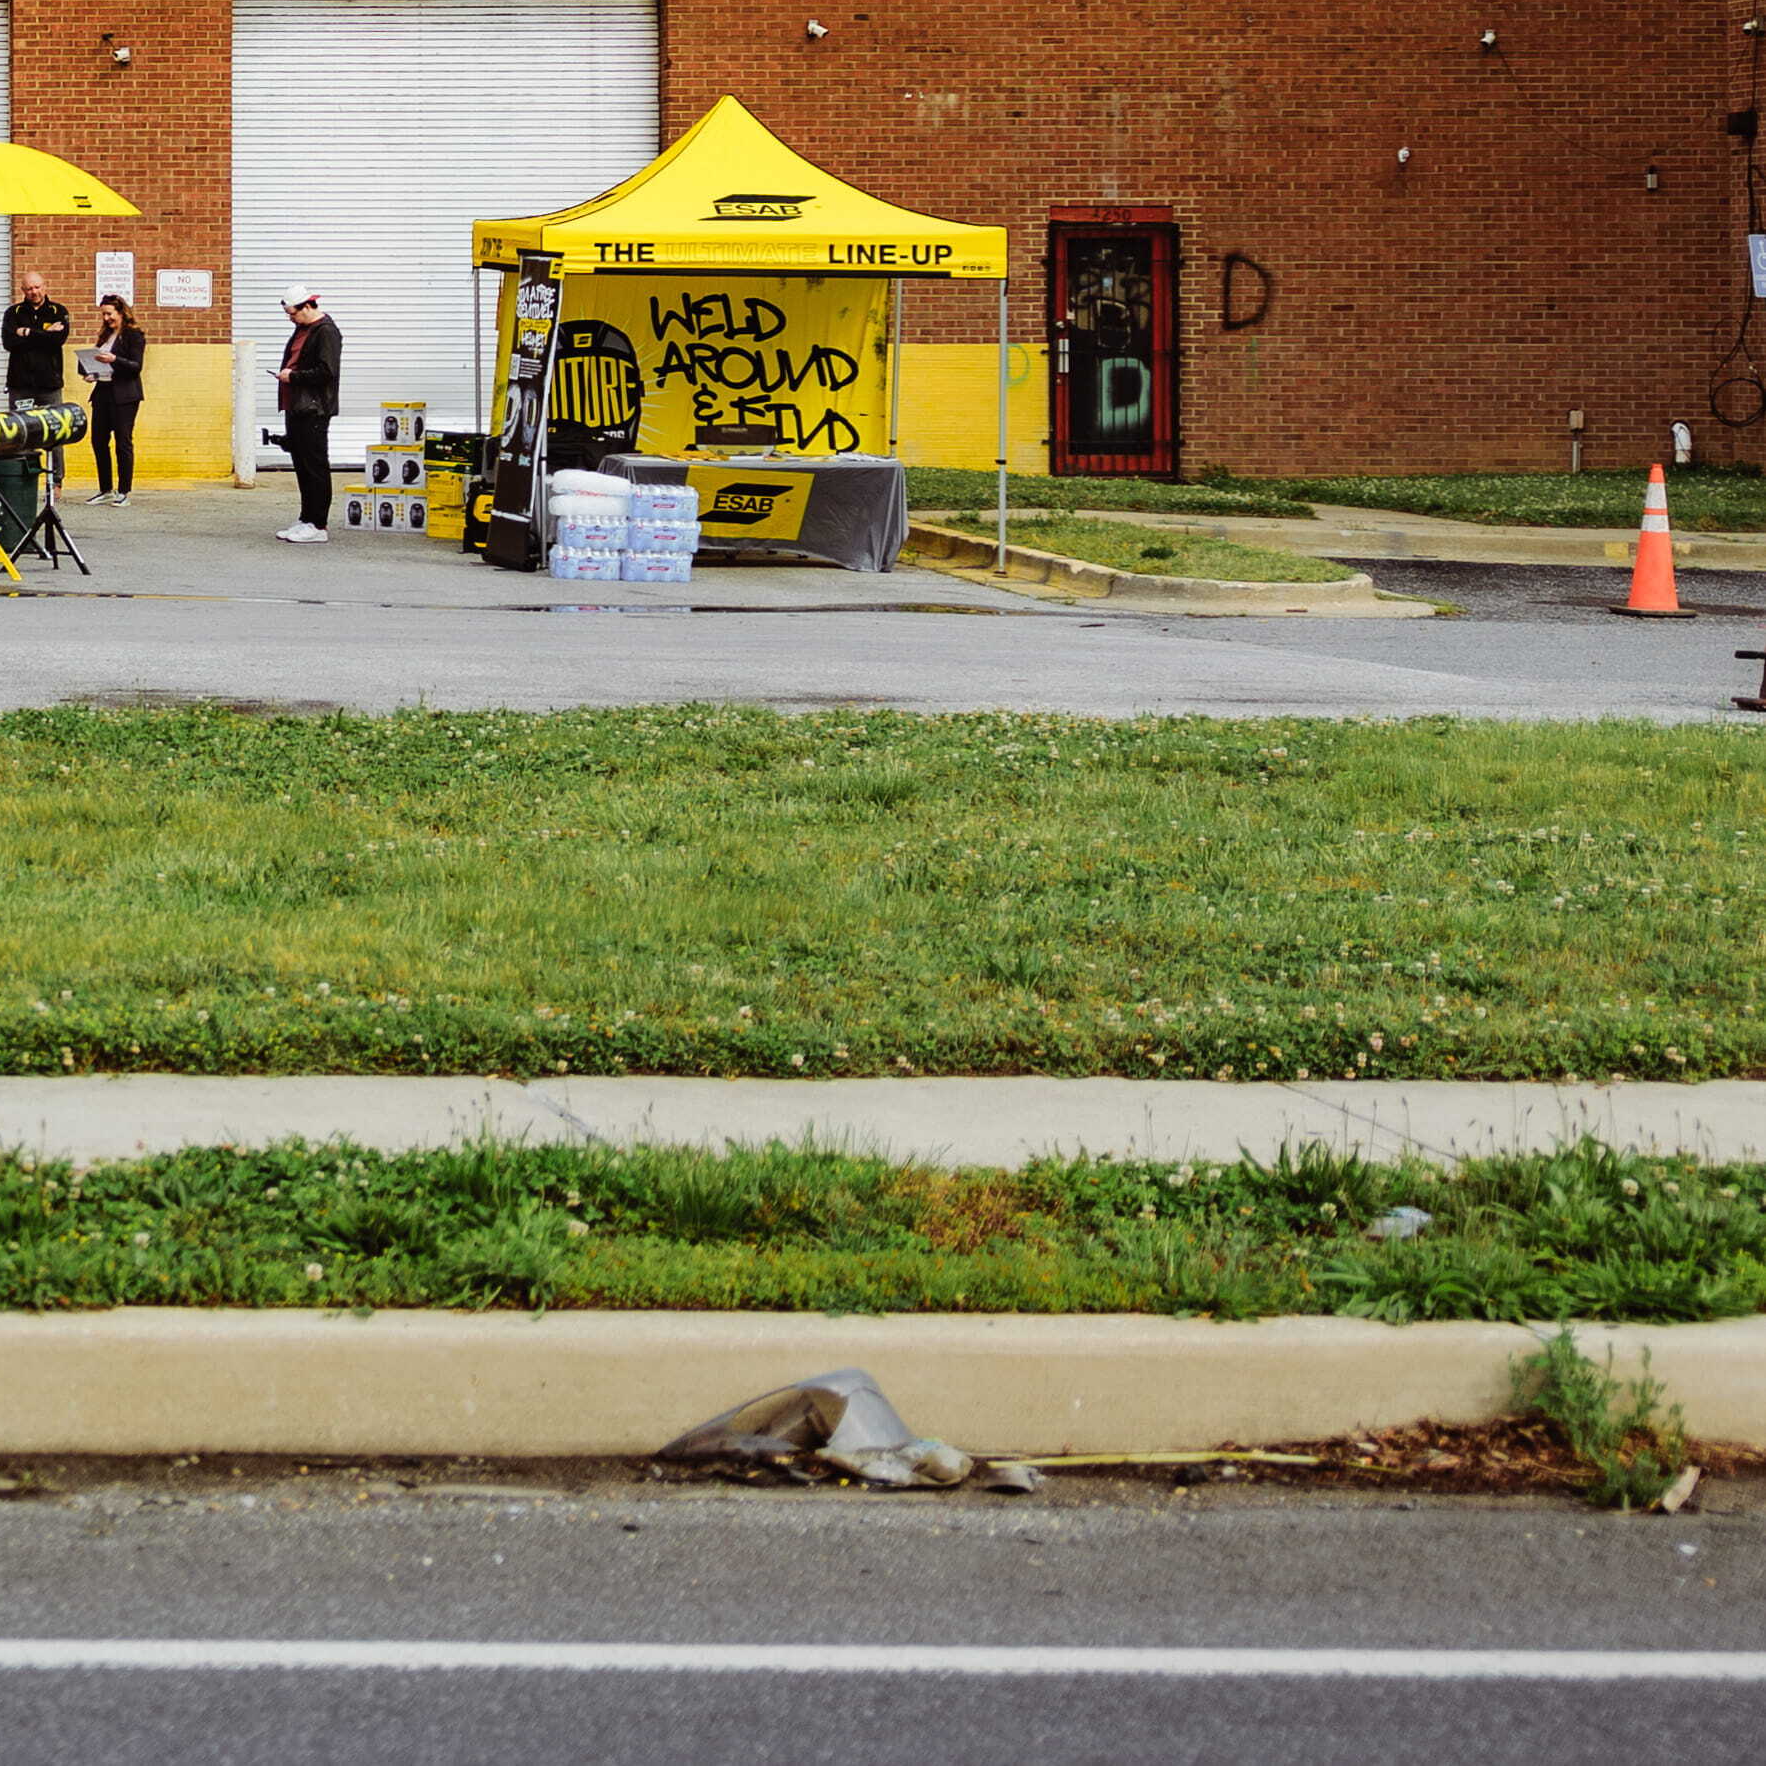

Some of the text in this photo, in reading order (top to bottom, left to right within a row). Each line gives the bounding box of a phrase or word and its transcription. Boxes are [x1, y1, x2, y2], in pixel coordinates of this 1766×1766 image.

[713, 201, 802, 218] ESAB
[594, 242, 655, 263] THE
[828, 243, 953, 265] LINE-UP
[177, 275, 192, 284] NO
[649, 292, 787, 342] WELD
[653, 341, 859, 392] AROUND
[713, 495, 774, 513] ESAB
